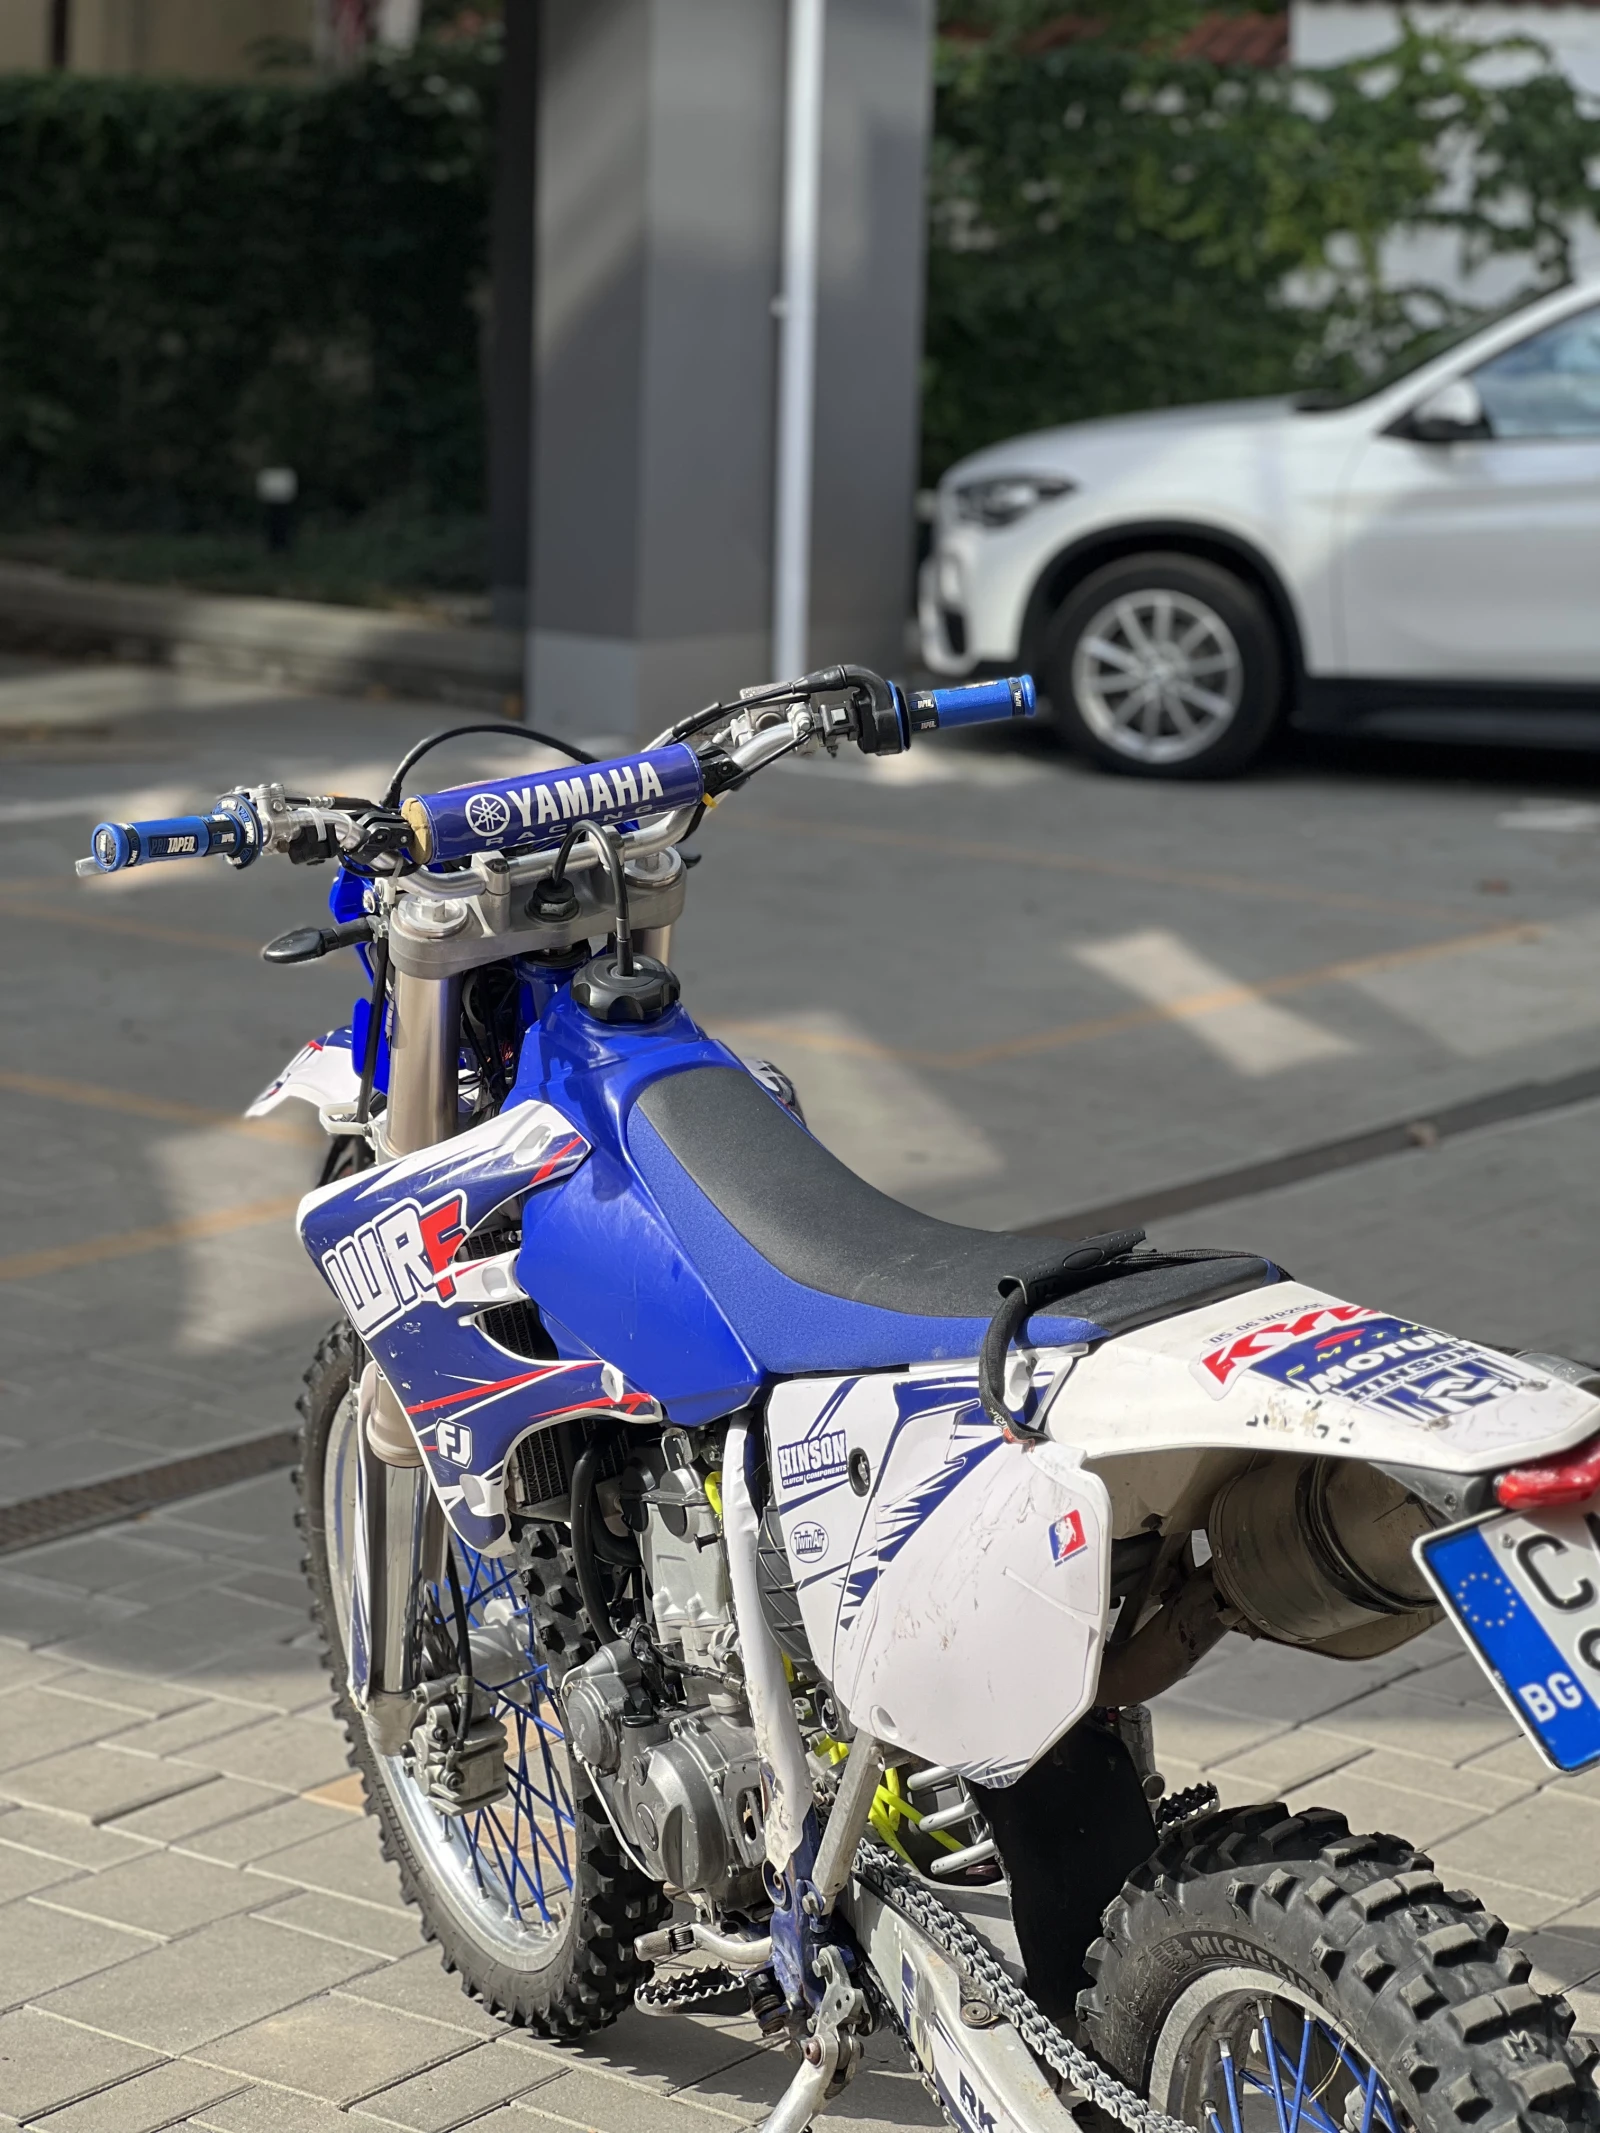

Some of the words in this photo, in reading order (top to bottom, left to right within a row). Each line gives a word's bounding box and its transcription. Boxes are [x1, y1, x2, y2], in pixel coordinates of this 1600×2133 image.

[506, 761, 664, 828] YAMAHA
[485, 804, 654, 847] RACNG
[322, 1191, 468, 1339] WRF
[1309, 1333, 1459, 1394] MOTUL
[778, 1432, 847, 1478] HINSON
[782, 1475, 804, 1486] CLUTCH
[806, 1465, 847, 1480] COMPONENTS
[1519, 1672, 1582, 1723] BG
[1191, 1936, 1318, 2001] MICHELIN
